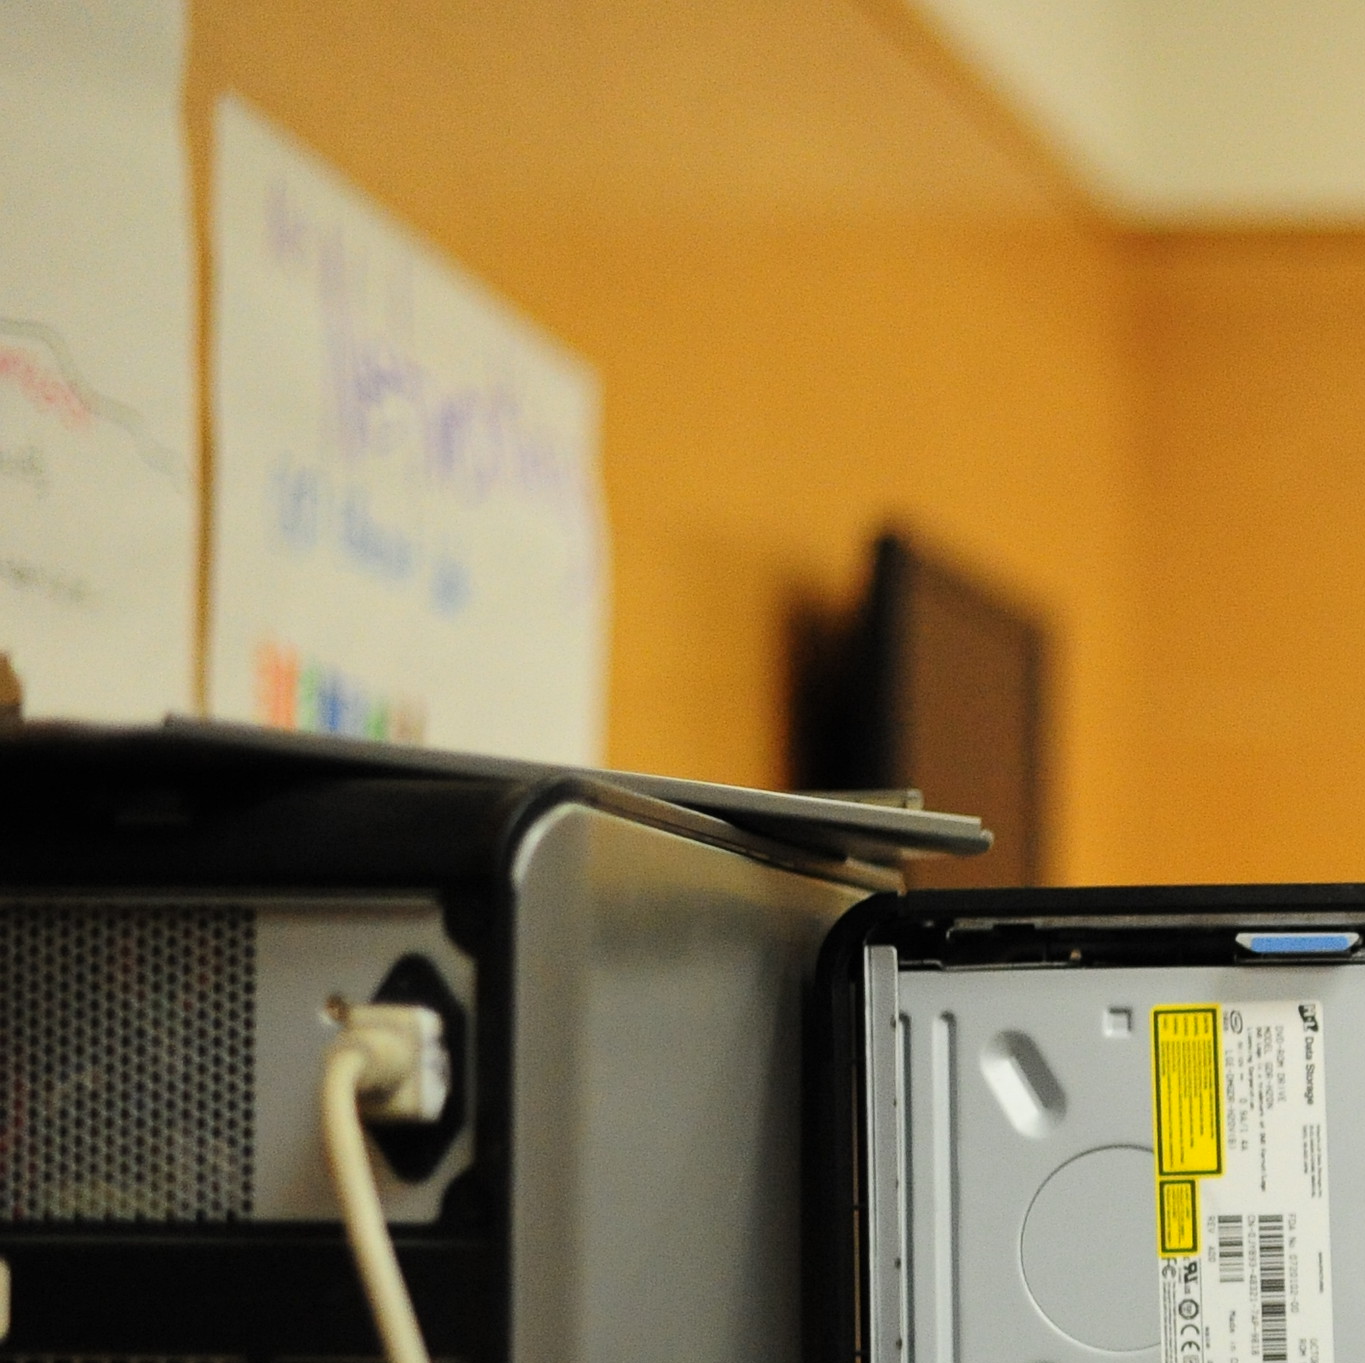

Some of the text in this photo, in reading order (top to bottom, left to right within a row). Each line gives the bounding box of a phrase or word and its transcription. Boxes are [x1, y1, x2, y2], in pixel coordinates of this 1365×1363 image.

[1263, 1026, 1273, 1055] MODEL
[1304, 1036, 1315, 1060] Data
[1274, 1026, 1287, 1103] DVD-ROM DRIVE
[1303, 1064, 1316, 1105] Storage
[1207, 1215, 1215, 1234] REV
[1288, 1213, 1297, 1231] FDA
[1229, 1311, 1237, 1333] Made
[1299, 1338, 1308, 1356] ROM
